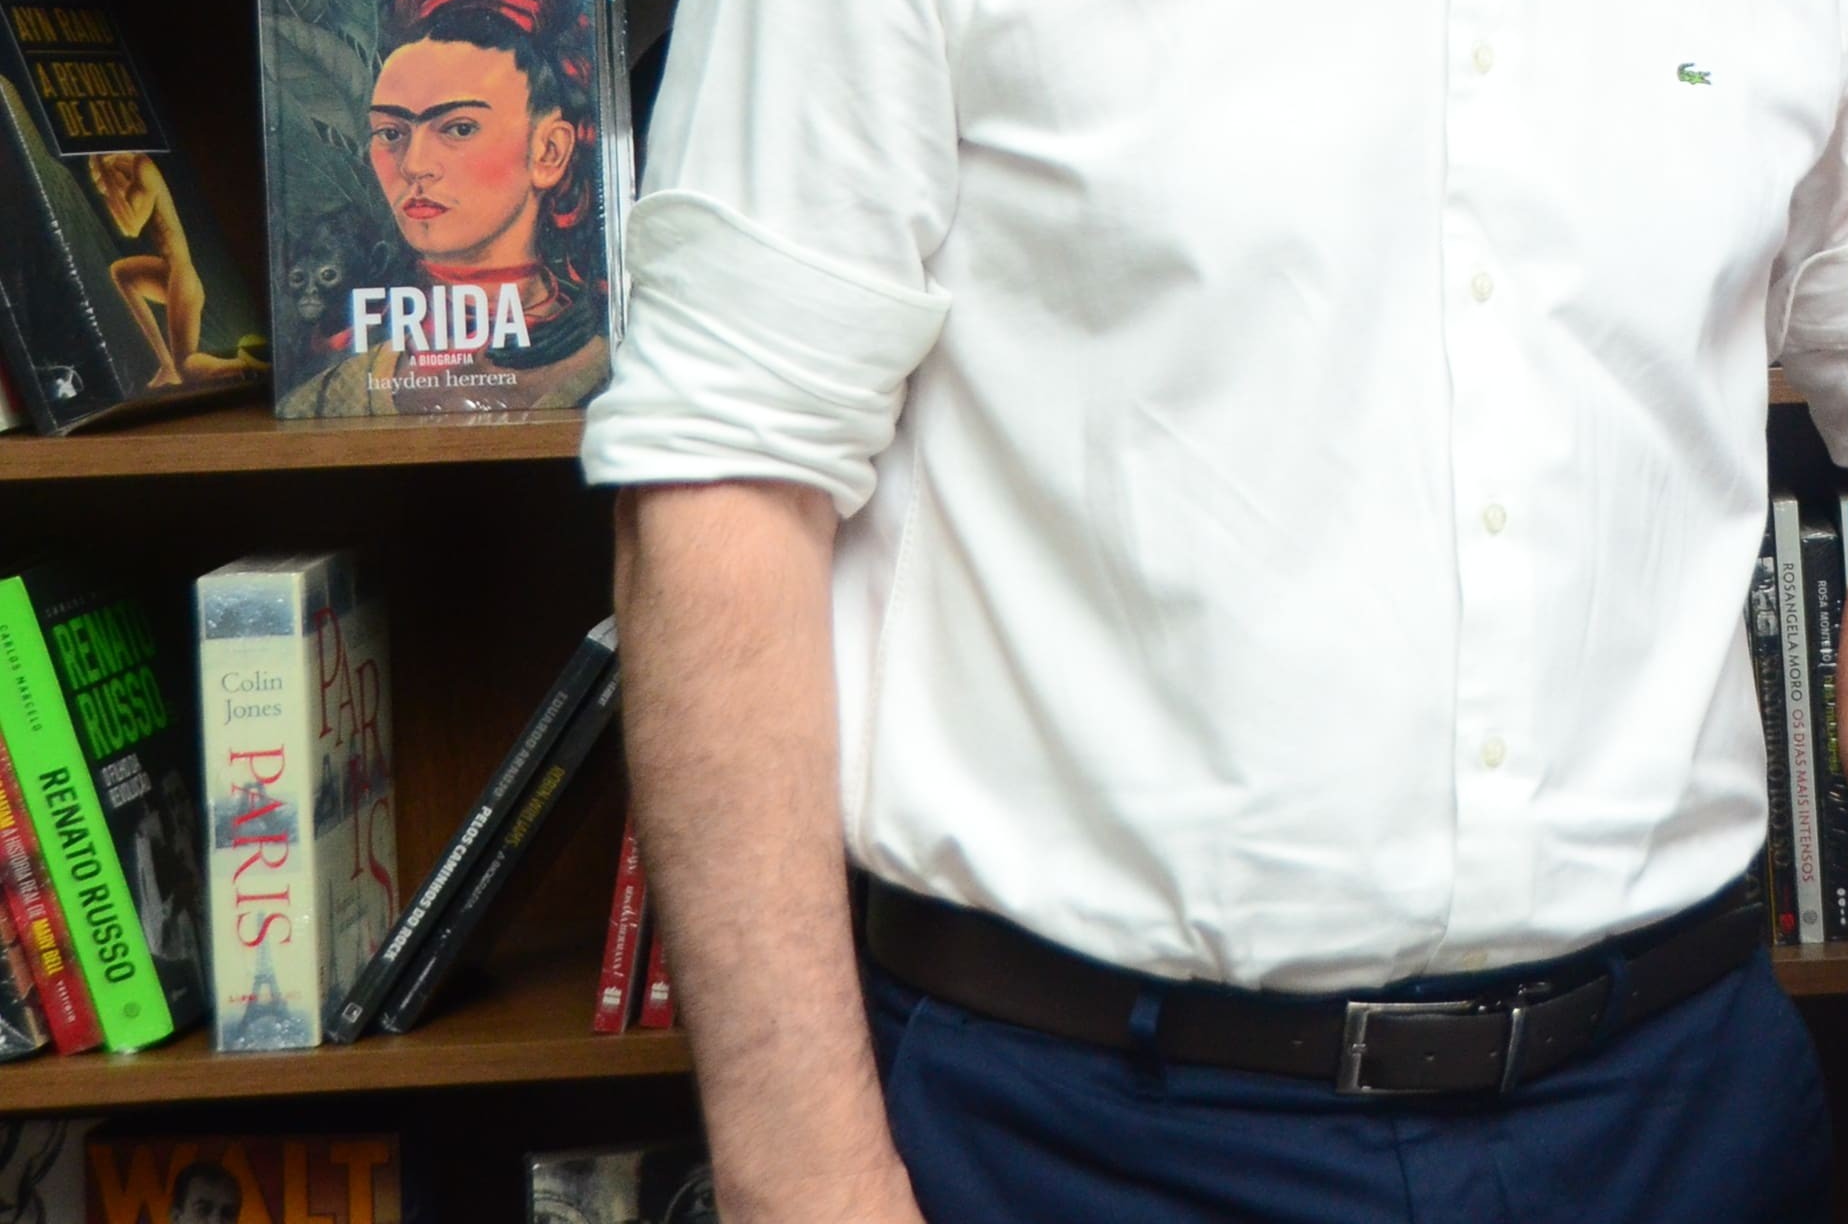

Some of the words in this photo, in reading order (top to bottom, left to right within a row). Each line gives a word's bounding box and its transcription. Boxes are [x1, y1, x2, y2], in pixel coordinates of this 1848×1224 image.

[11, 6, 54, 42] AYN
[36, 63, 52, 100] A
[51, 61, 139, 99] REVOLTA
[59, 102, 92, 137] DE
[90, 102, 148, 136] ATLAS
[351, 284, 531, 354] FRIDA
[409, 355, 417, 366] A
[419, 353, 474, 366] BIOGRAFIA
[367, 371, 440, 393] hayden
[444, 370, 517, 387] herrera
[1783, 562, 1799, 651] ROSANGELA
[221, 672, 283, 693] Colin
[1789, 655, 1803, 703] MORO
[224, 700, 282, 725] Jones
[1791, 708, 1804, 727] OS
[1793, 731, 1805, 761] DIAS
[1795, 763, 1808, 797] MAIS
[228, 744, 292, 950] PARIS
[1798, 800, 1814, 883] INTENSOS
[38, 765, 103, 884] RENATO
[77, 883, 138, 987] RUSSO
